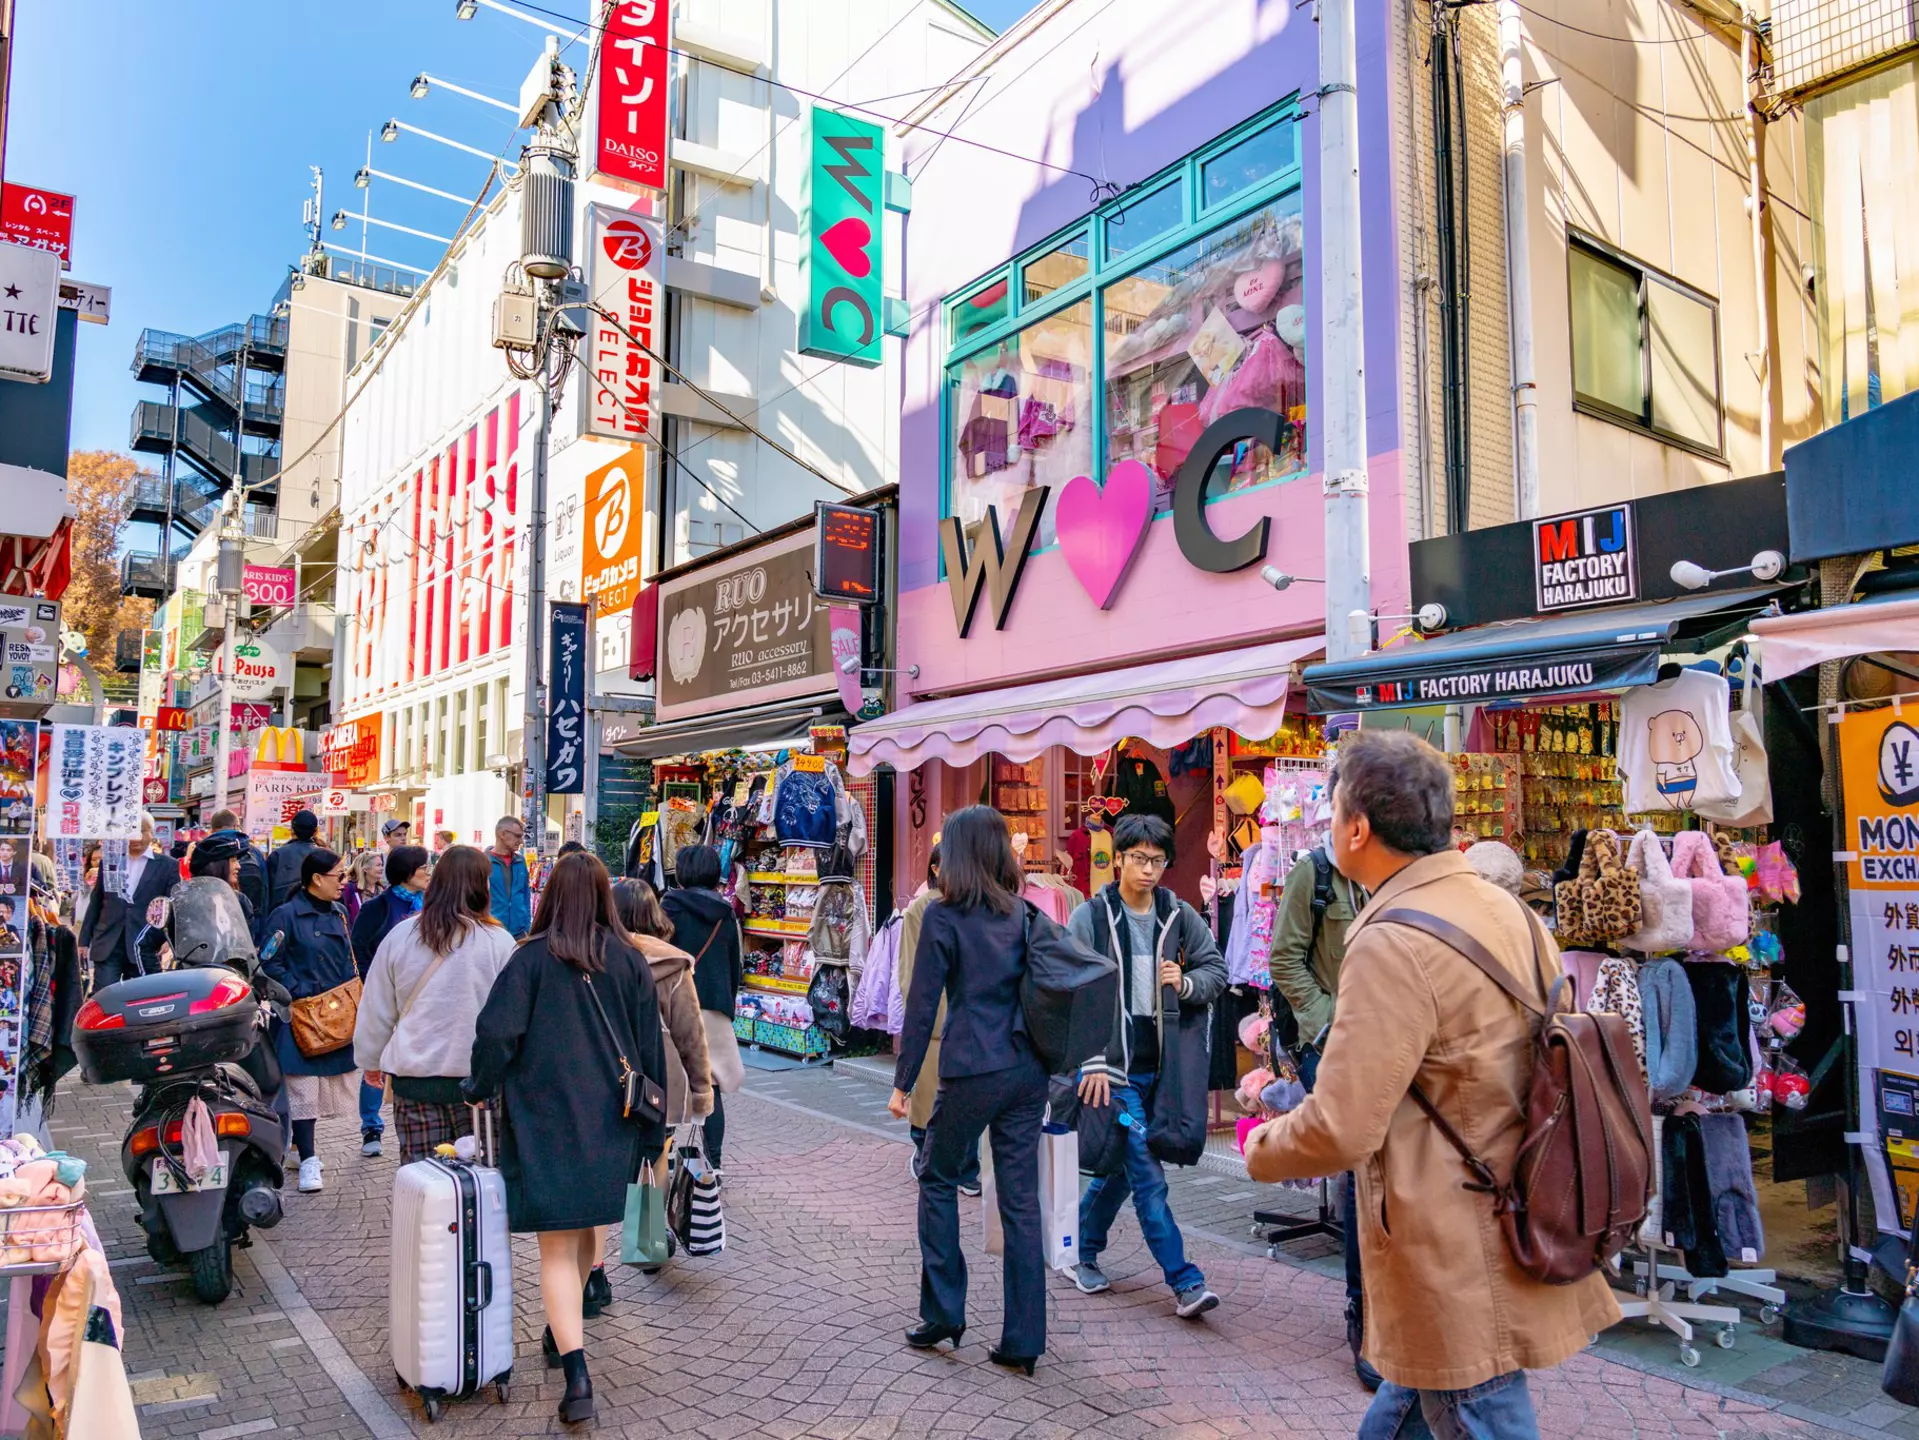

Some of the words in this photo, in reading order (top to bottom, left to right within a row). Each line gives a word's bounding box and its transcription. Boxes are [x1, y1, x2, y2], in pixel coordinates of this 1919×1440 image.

[604, 138, 659, 163] DAISO
[50, 198, 70, 208] 2F
[5, 221, 31, 232] レンタル
[36, 227, 61, 238] スペース
[1243, 282, 1265, 298] MINE
[624, 277, 653, 434] ビックカメラ
[597, 308, 620, 430] SELECT
[1539, 511, 1626, 563] MIJ
[243, 570, 264, 580] ARIS
[584, 556, 638, 597] ビックカメラ
[1542, 551, 1626, 586] FACTORY
[249, 582, 288, 603] 300
[596, 586, 629, 611] ELECT
[713, 567, 768, 615] RUO
[1543, 576, 1627, 606] HARAJUKU
[712, 592, 831, 653] アクセサリー
[757, 640, 807, 661] accessory
[831, 637, 860, 656] SALE
[236, 657, 276, 679] Pausa
[560, 632, 579, 694] ギャラリー
[751, 661, 808, 685] 03-5411-8862
[1379, 680, 1414, 703] MIJ
[1420, 673, 1491, 699] FACTORY
[1494, 663, 1594, 693] HARAJUKU
[329, 721, 358, 751] CAMERA
[549, 698, 583, 791] ハセガワ
[321, 749, 349, 774] SELECT
[255, 783, 292, 793] PARIS
[1863, 856, 1919, 882] EXCH
[1894, 1028, 1919, 1058] 외
